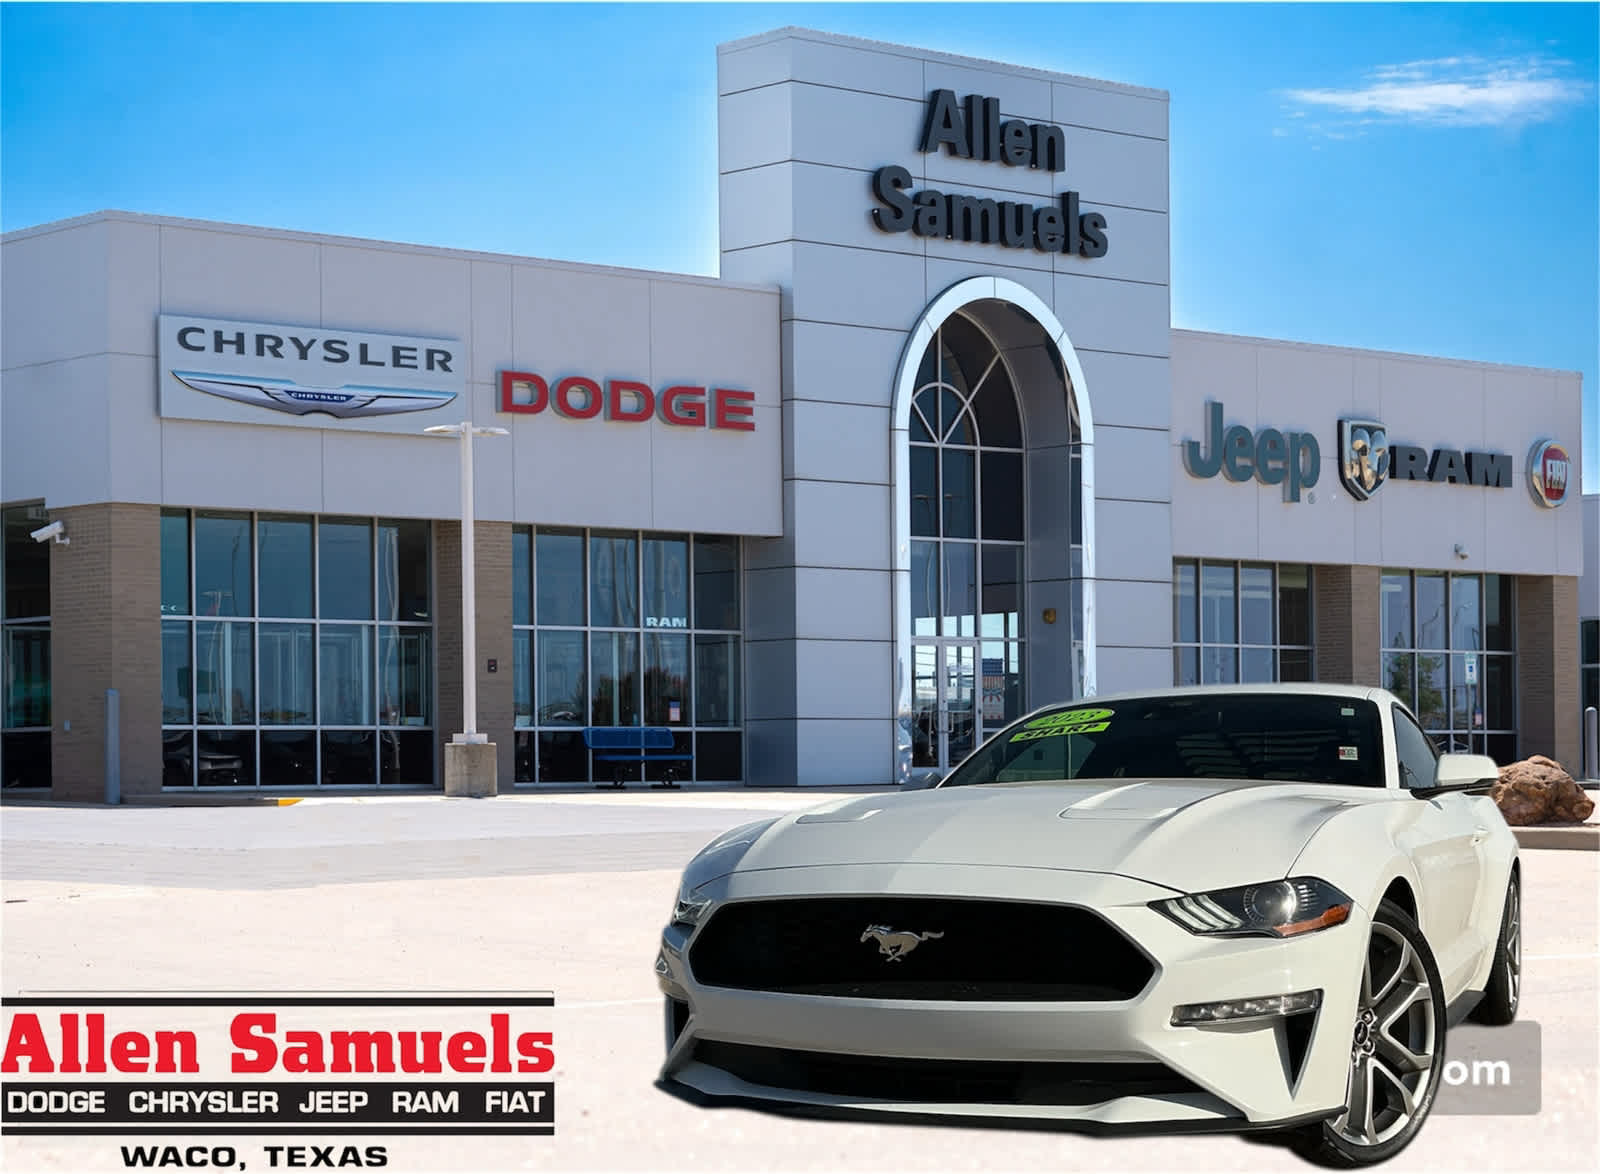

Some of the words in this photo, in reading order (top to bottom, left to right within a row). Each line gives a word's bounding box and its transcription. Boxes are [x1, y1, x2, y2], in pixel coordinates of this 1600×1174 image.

[919, 88, 1066, 172] Allen
[872, 165, 1108, 258] Samuels
[177, 326, 453, 373] CHRYSLER
[291, 392, 347, 401] CHRYSLER
[496, 370, 755, 432] DODGE
[1183, 401, 1321, 503] Jeep
[1389, 445, 1513, 488] RAM
[645, 616, 687, 628] RAM
[1018, 722, 1100, 739] SHARP
